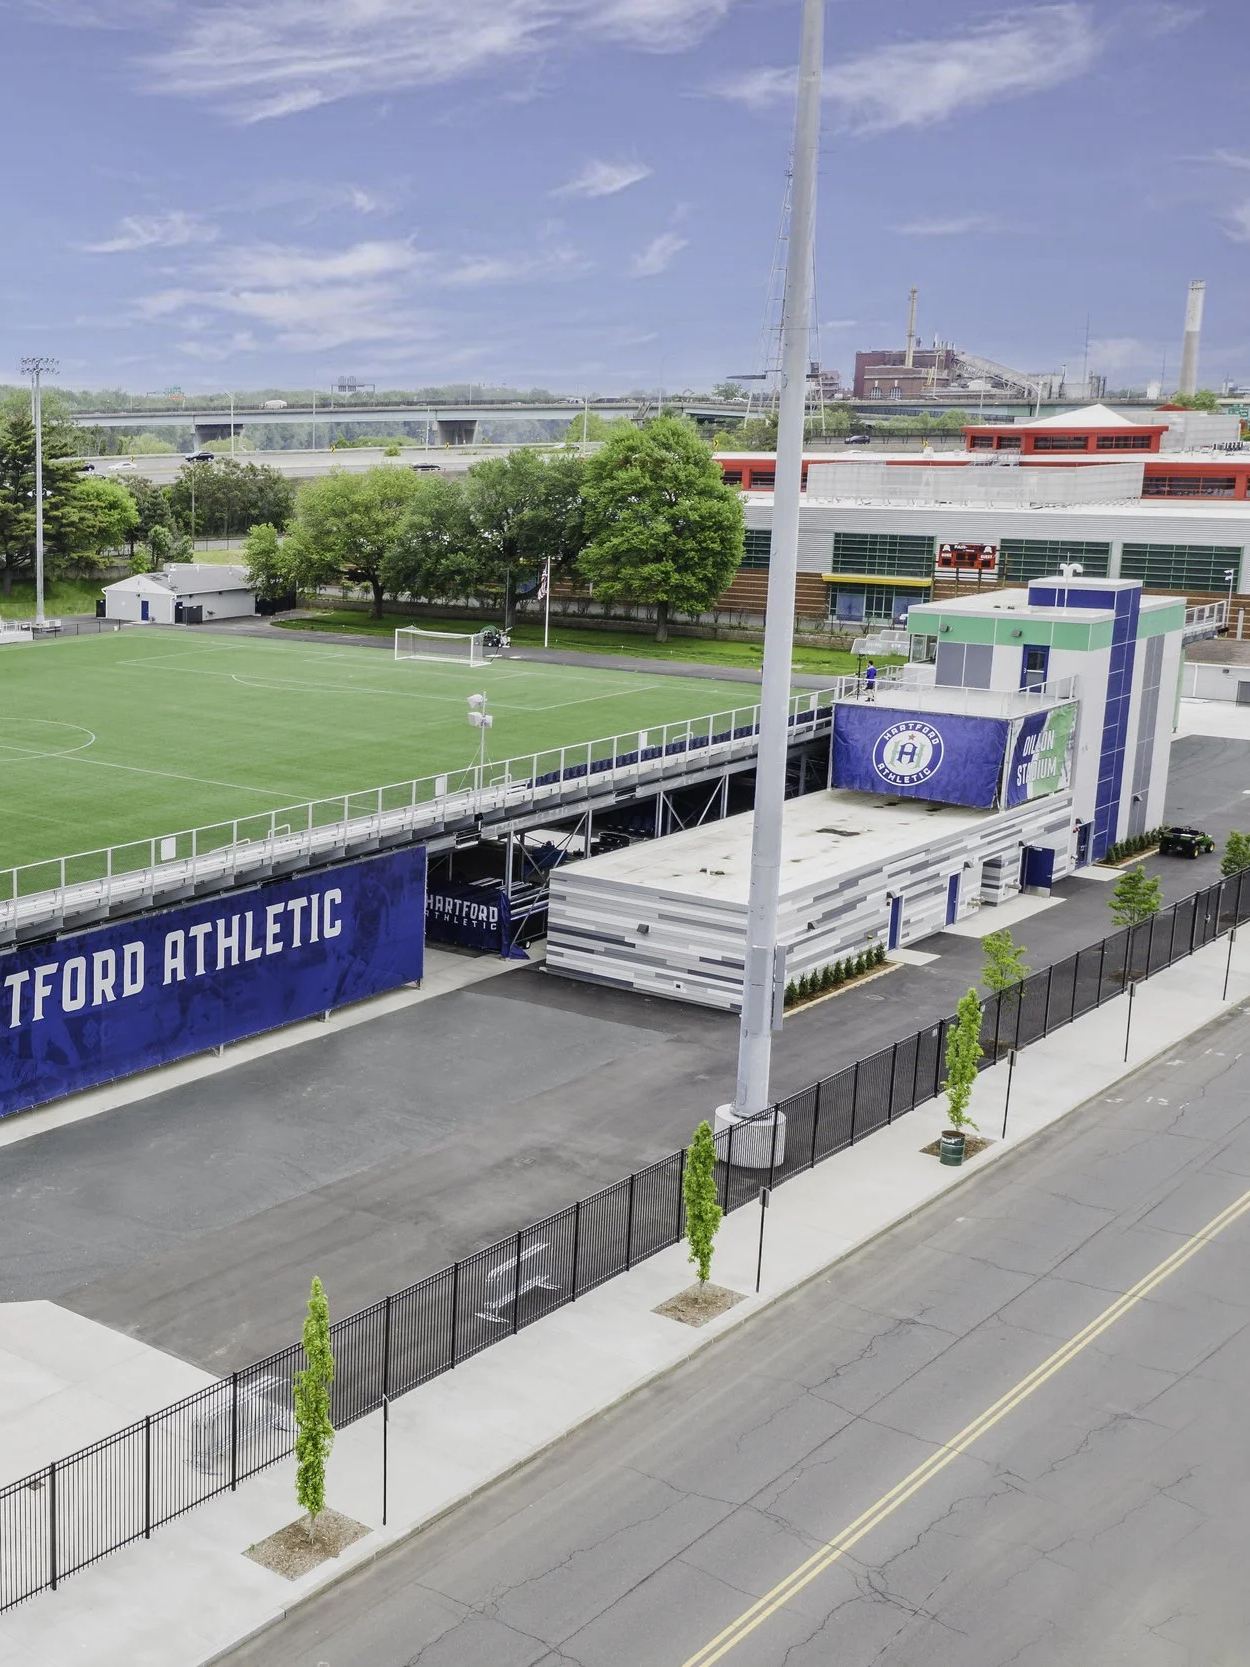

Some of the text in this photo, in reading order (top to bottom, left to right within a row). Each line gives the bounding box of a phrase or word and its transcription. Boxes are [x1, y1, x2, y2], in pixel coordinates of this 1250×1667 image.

[883, 723, 940, 745] HARTFORD
[1022, 730, 1055, 757] DILLON
[877, 762, 931, 783] ATHLETIC
[1016, 756, 1057, 787] STADIUM
[425, 912, 497, 930] ATHLETIC
[426, 894, 498, 922] HARTFORD
[163, 887, 342, 986] ATHLETIC
